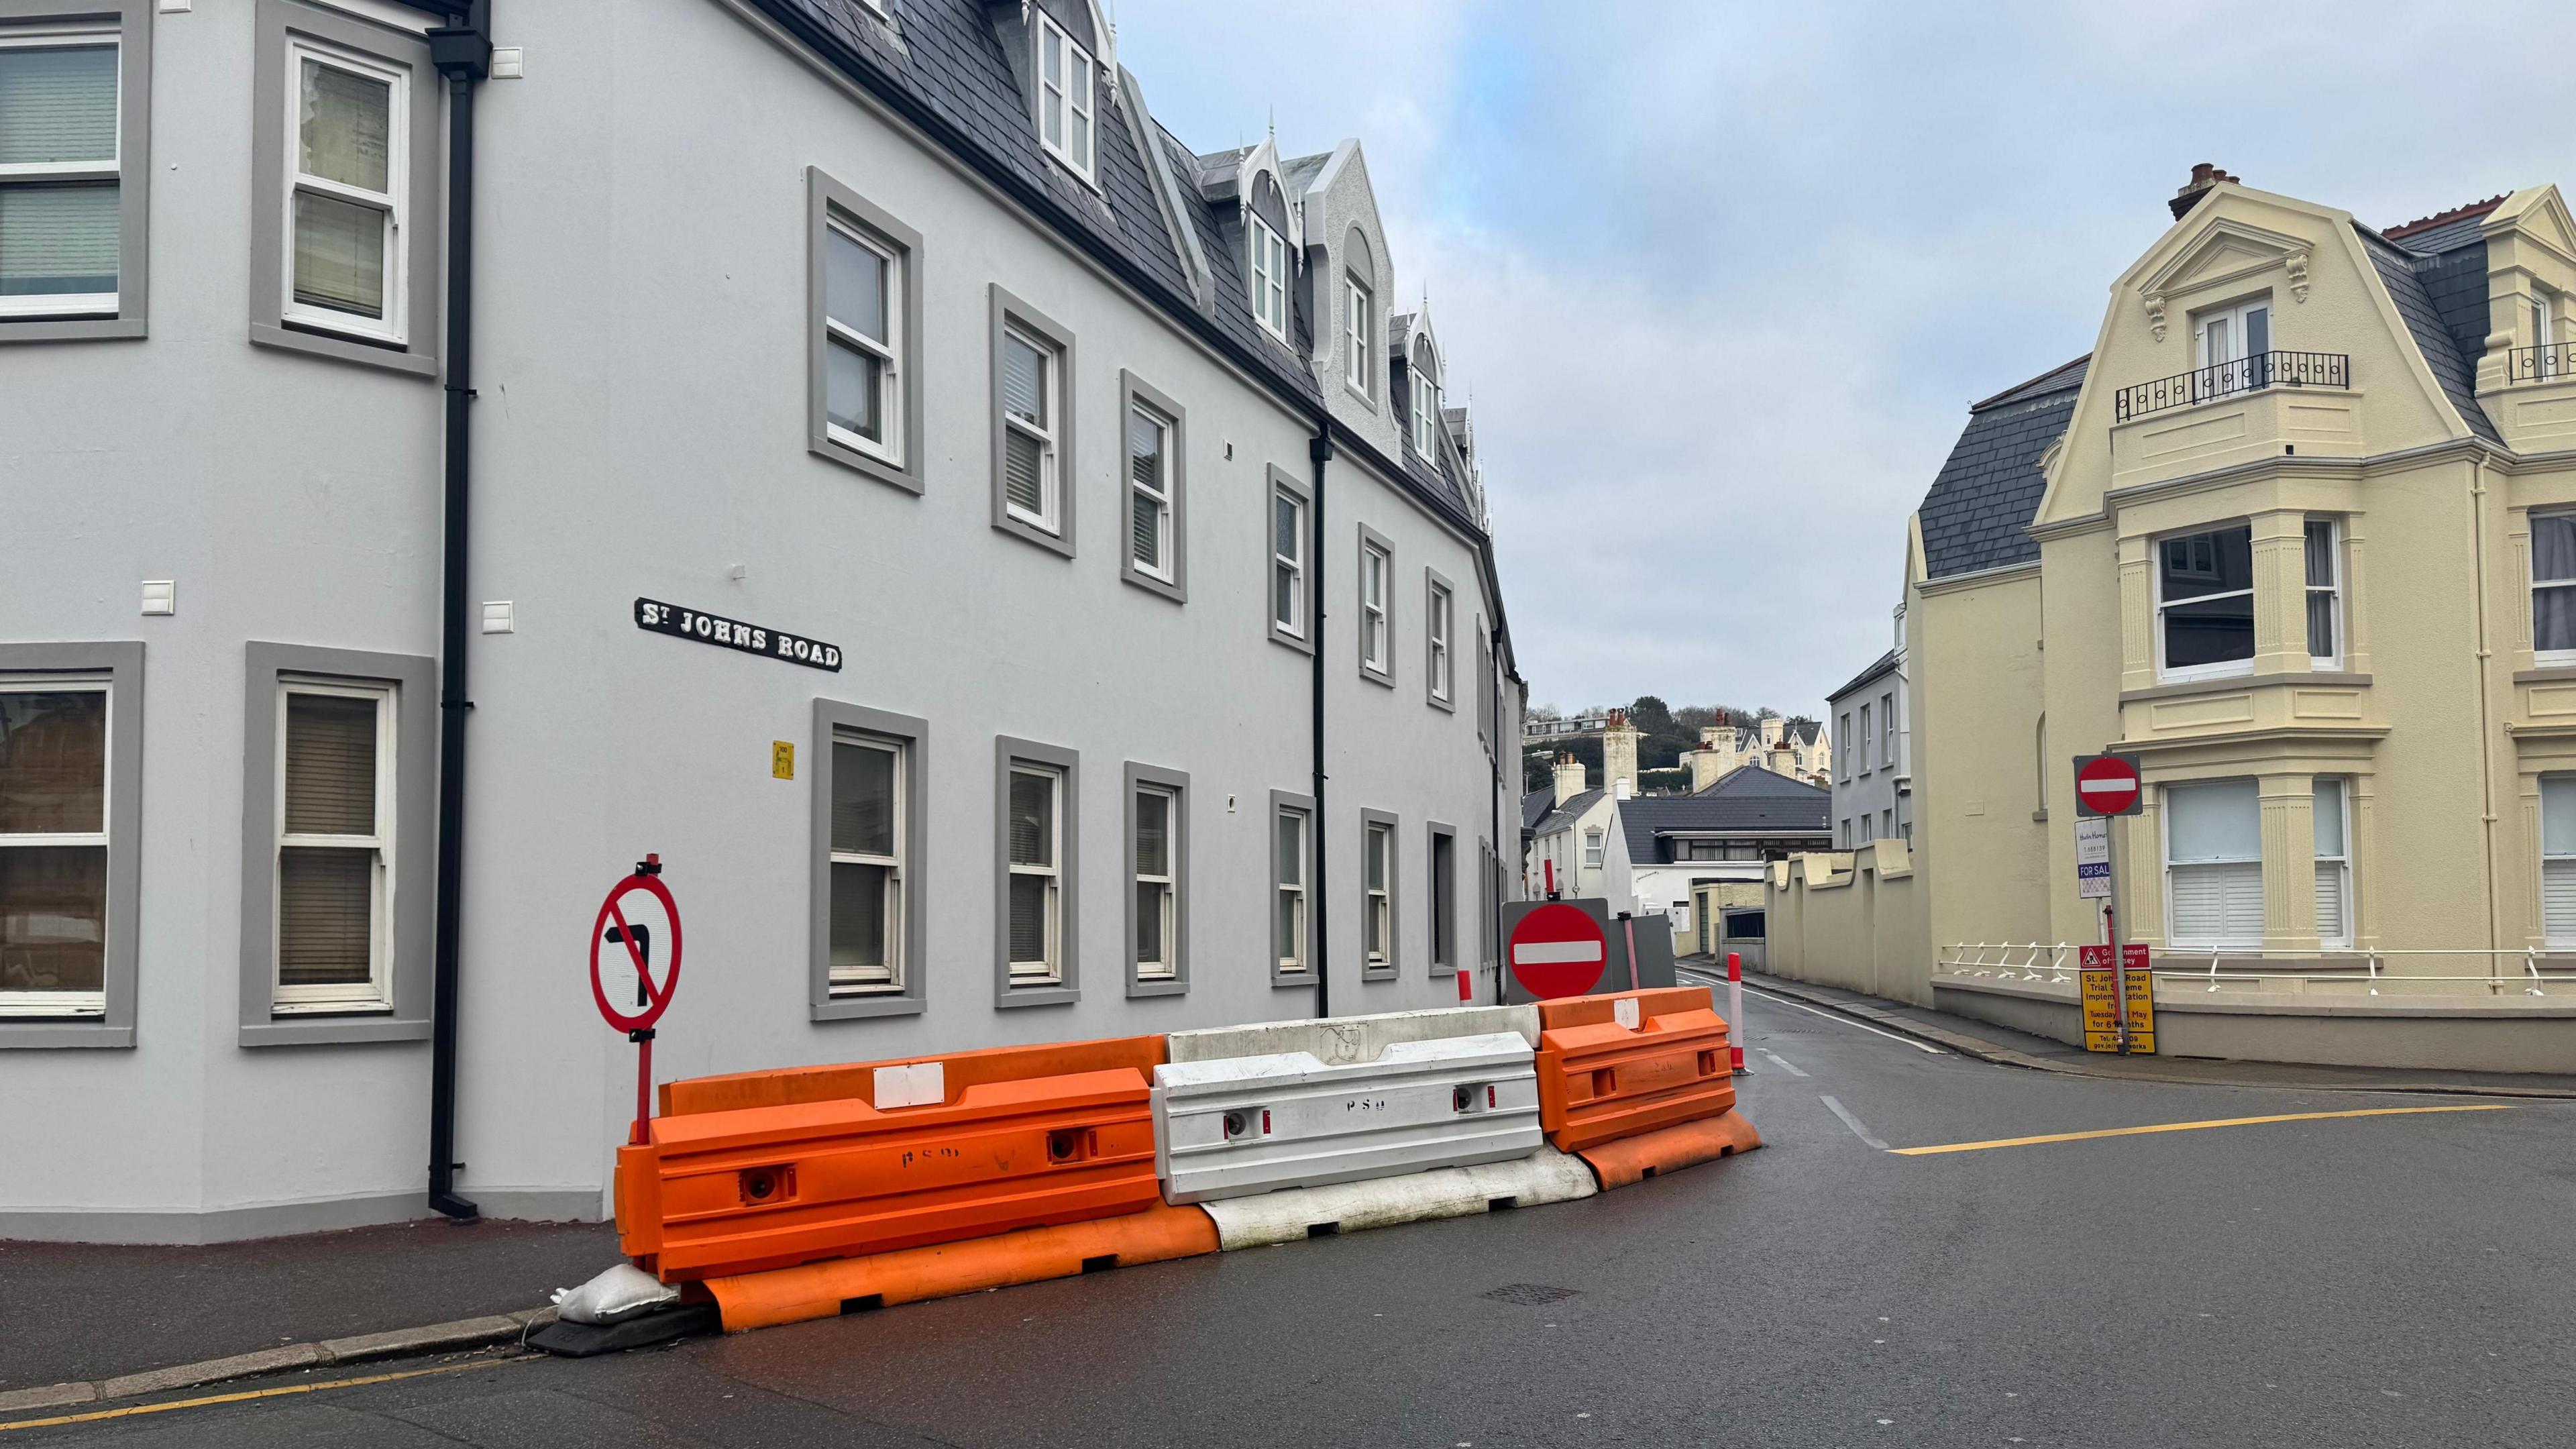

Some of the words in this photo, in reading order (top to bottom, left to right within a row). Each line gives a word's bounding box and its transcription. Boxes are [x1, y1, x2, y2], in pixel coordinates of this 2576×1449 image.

[680, 612, 766, 649] JOHNS
[778, 635, 839, 666] ROAD
[2081, 867, 2093, 876] FOR
[2094, 865, 2110, 875] SAL
[2090, 1011, 2116, 1019] Tuesday
[2132, 1011, 2147, 1019] May
